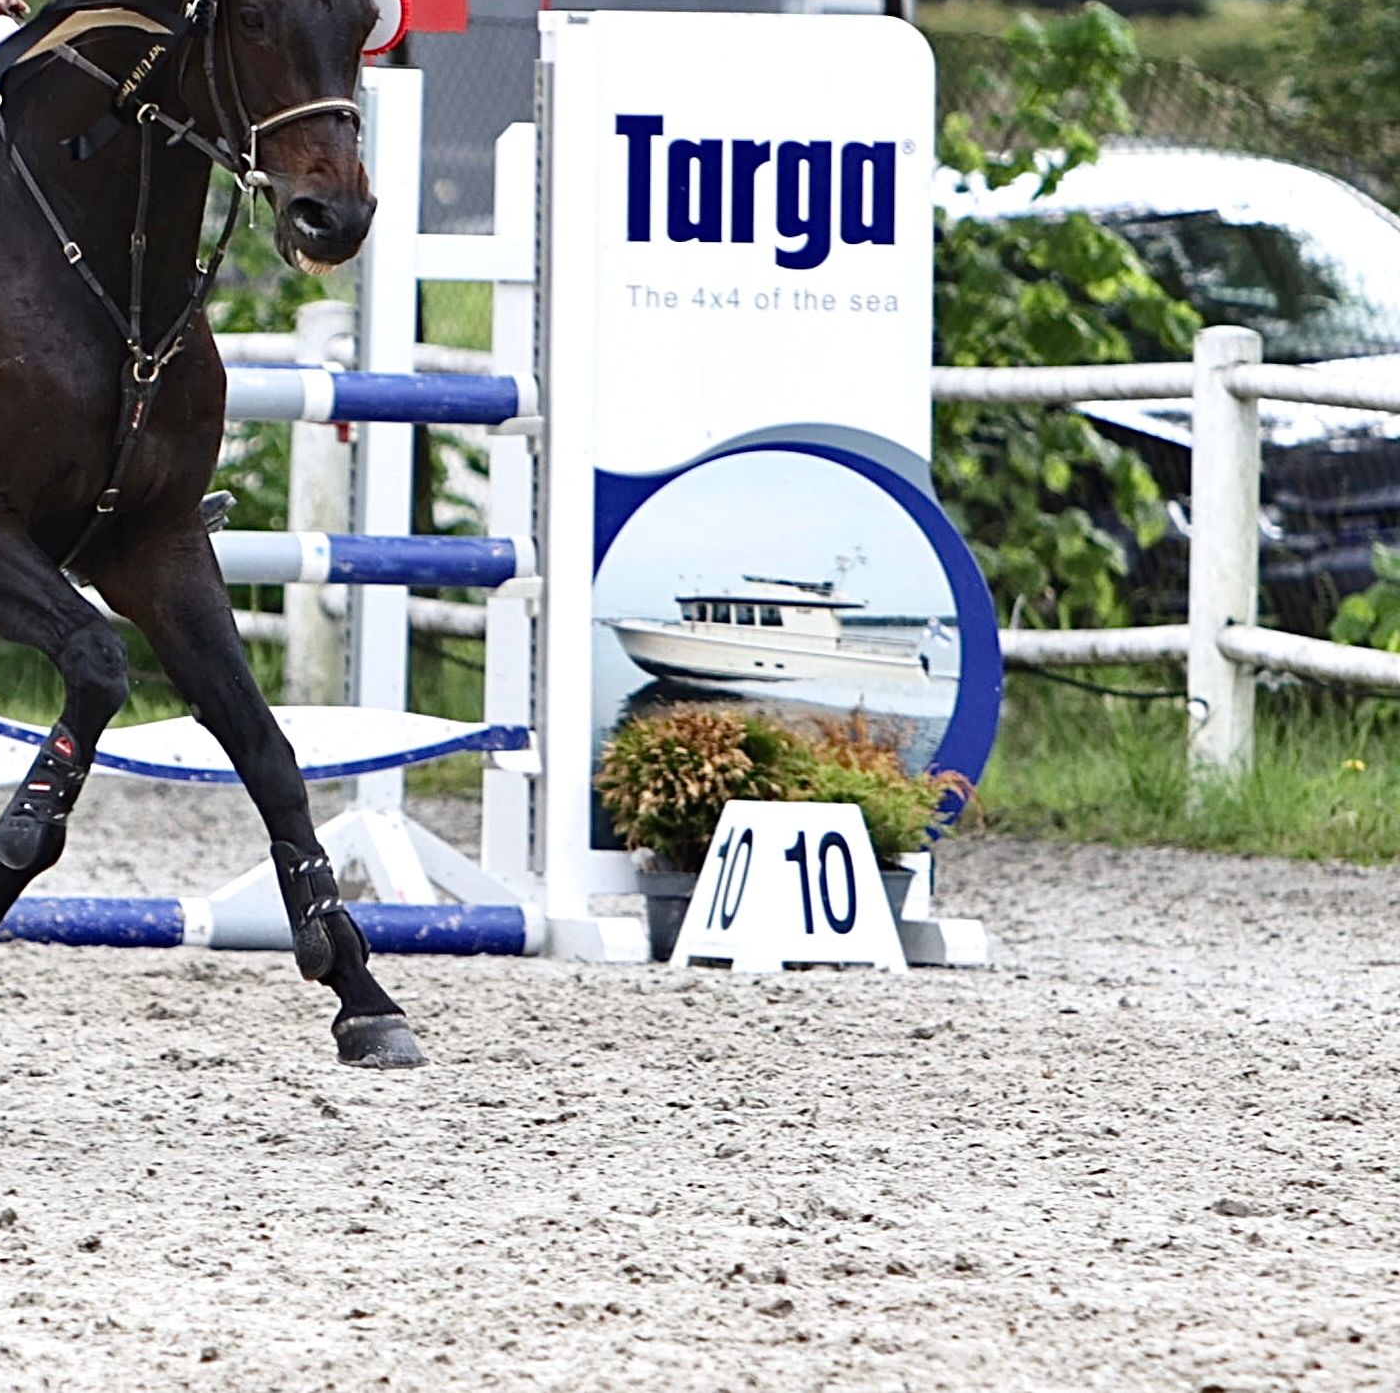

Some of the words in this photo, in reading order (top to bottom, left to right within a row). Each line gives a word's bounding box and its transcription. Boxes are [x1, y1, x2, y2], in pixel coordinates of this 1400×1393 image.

[614, 113, 897, 270] Targa
[625, 284, 679, 309] The
[690, 286, 741, 309] 4x4
[753, 287, 782, 310] of
[792, 288, 837, 311] the
[849, 293, 899, 313] sea
[706, 826, 753, 930] 10
[784, 830, 858, 934] 10
